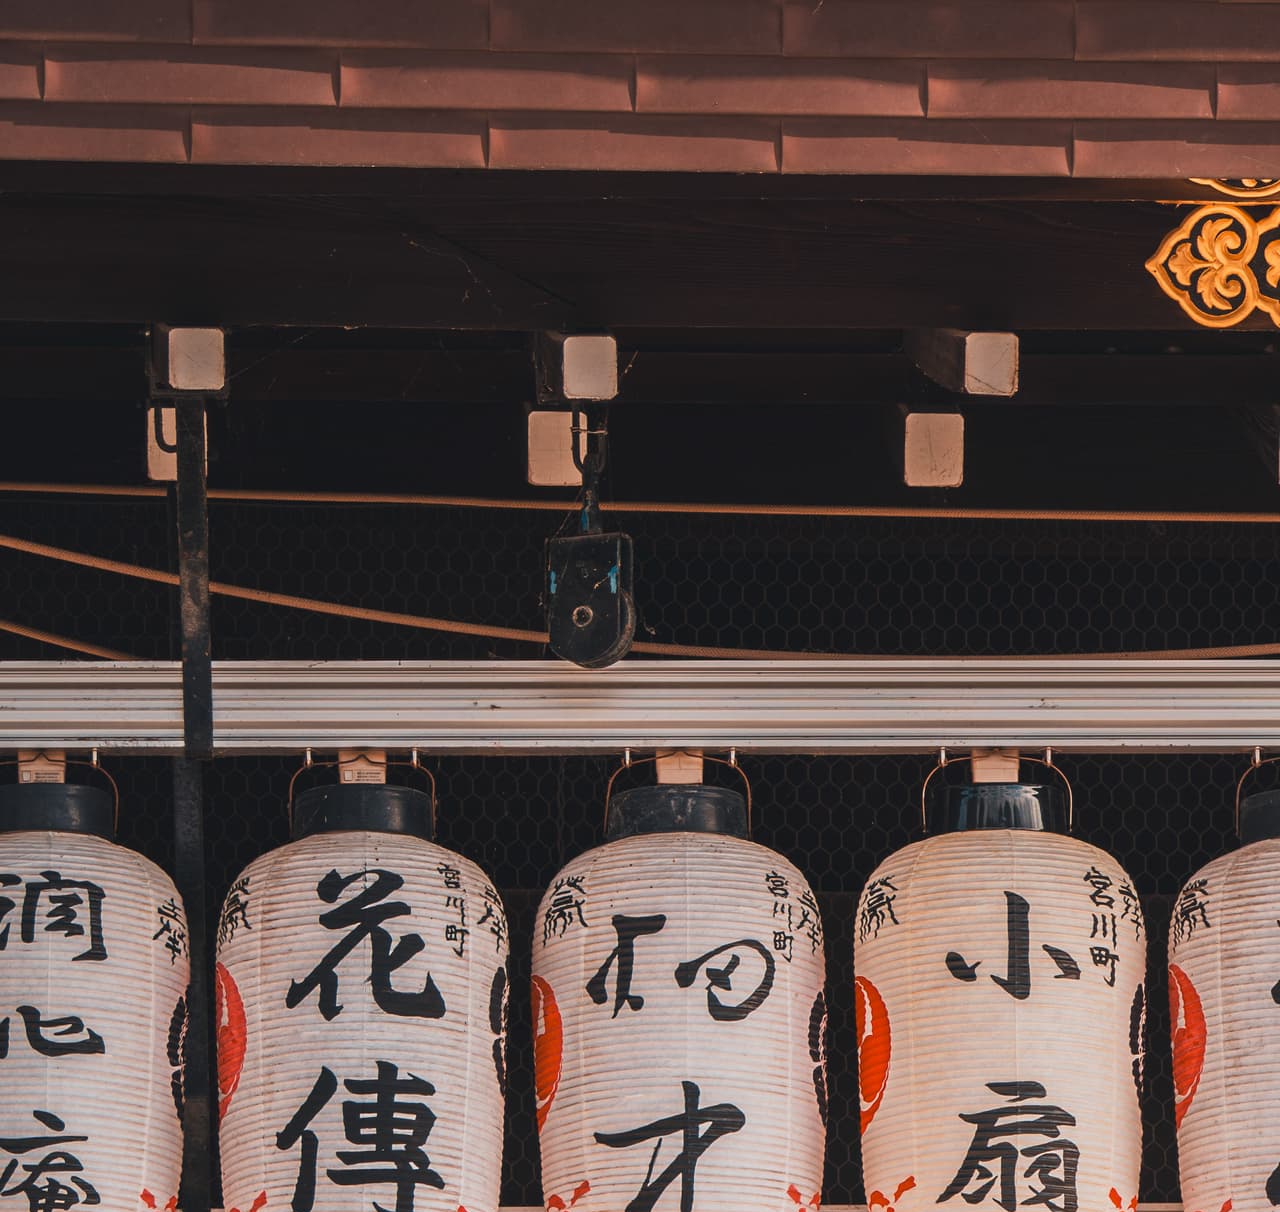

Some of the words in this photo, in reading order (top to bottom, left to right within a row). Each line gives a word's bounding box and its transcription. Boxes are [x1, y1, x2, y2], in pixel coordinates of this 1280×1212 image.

[436, 863, 469, 958] 宮川町
[764, 870, 795, 961] 宮川町
[1083, 867, 1120, 988] 宮川町
